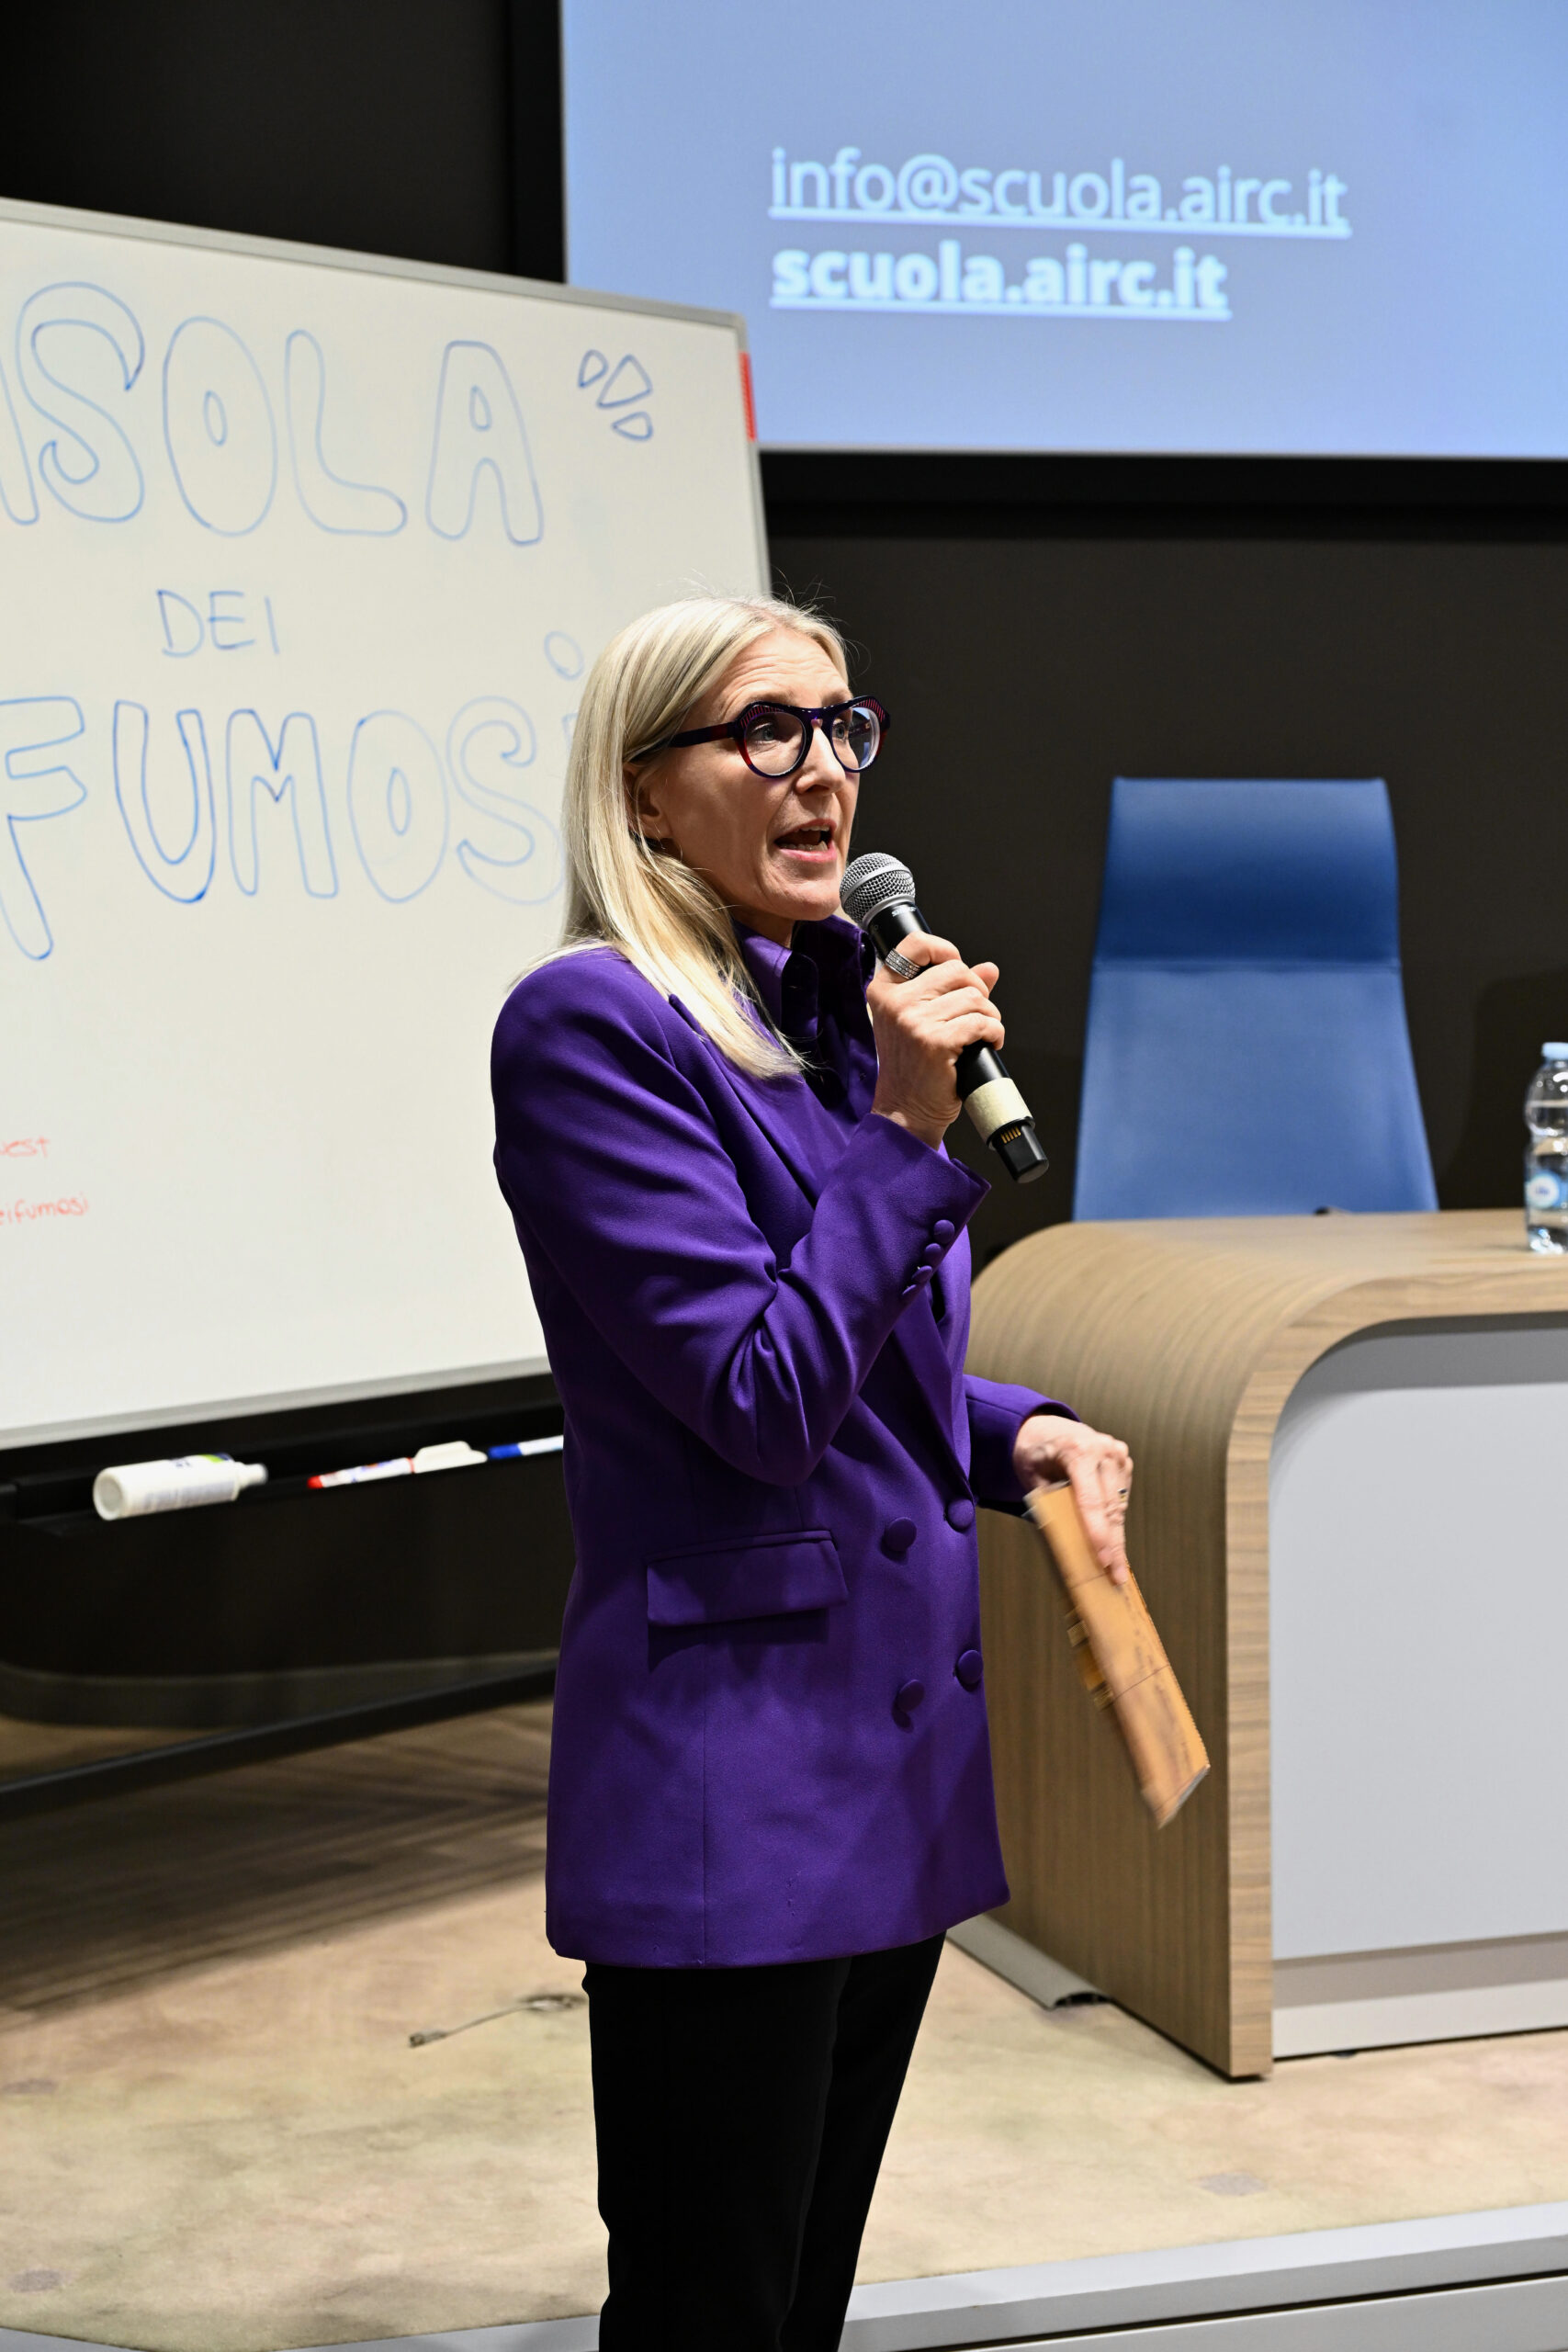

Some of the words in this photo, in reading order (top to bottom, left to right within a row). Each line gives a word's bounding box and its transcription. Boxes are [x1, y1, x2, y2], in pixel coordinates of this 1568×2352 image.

[772, 147, 1348, 226] info@scuola.airc.it
[772, 240, 1228, 309] scuola.airc.it
[157, 590, 279, 657] DEI
[0, 630, 582, 961] FUMOS
